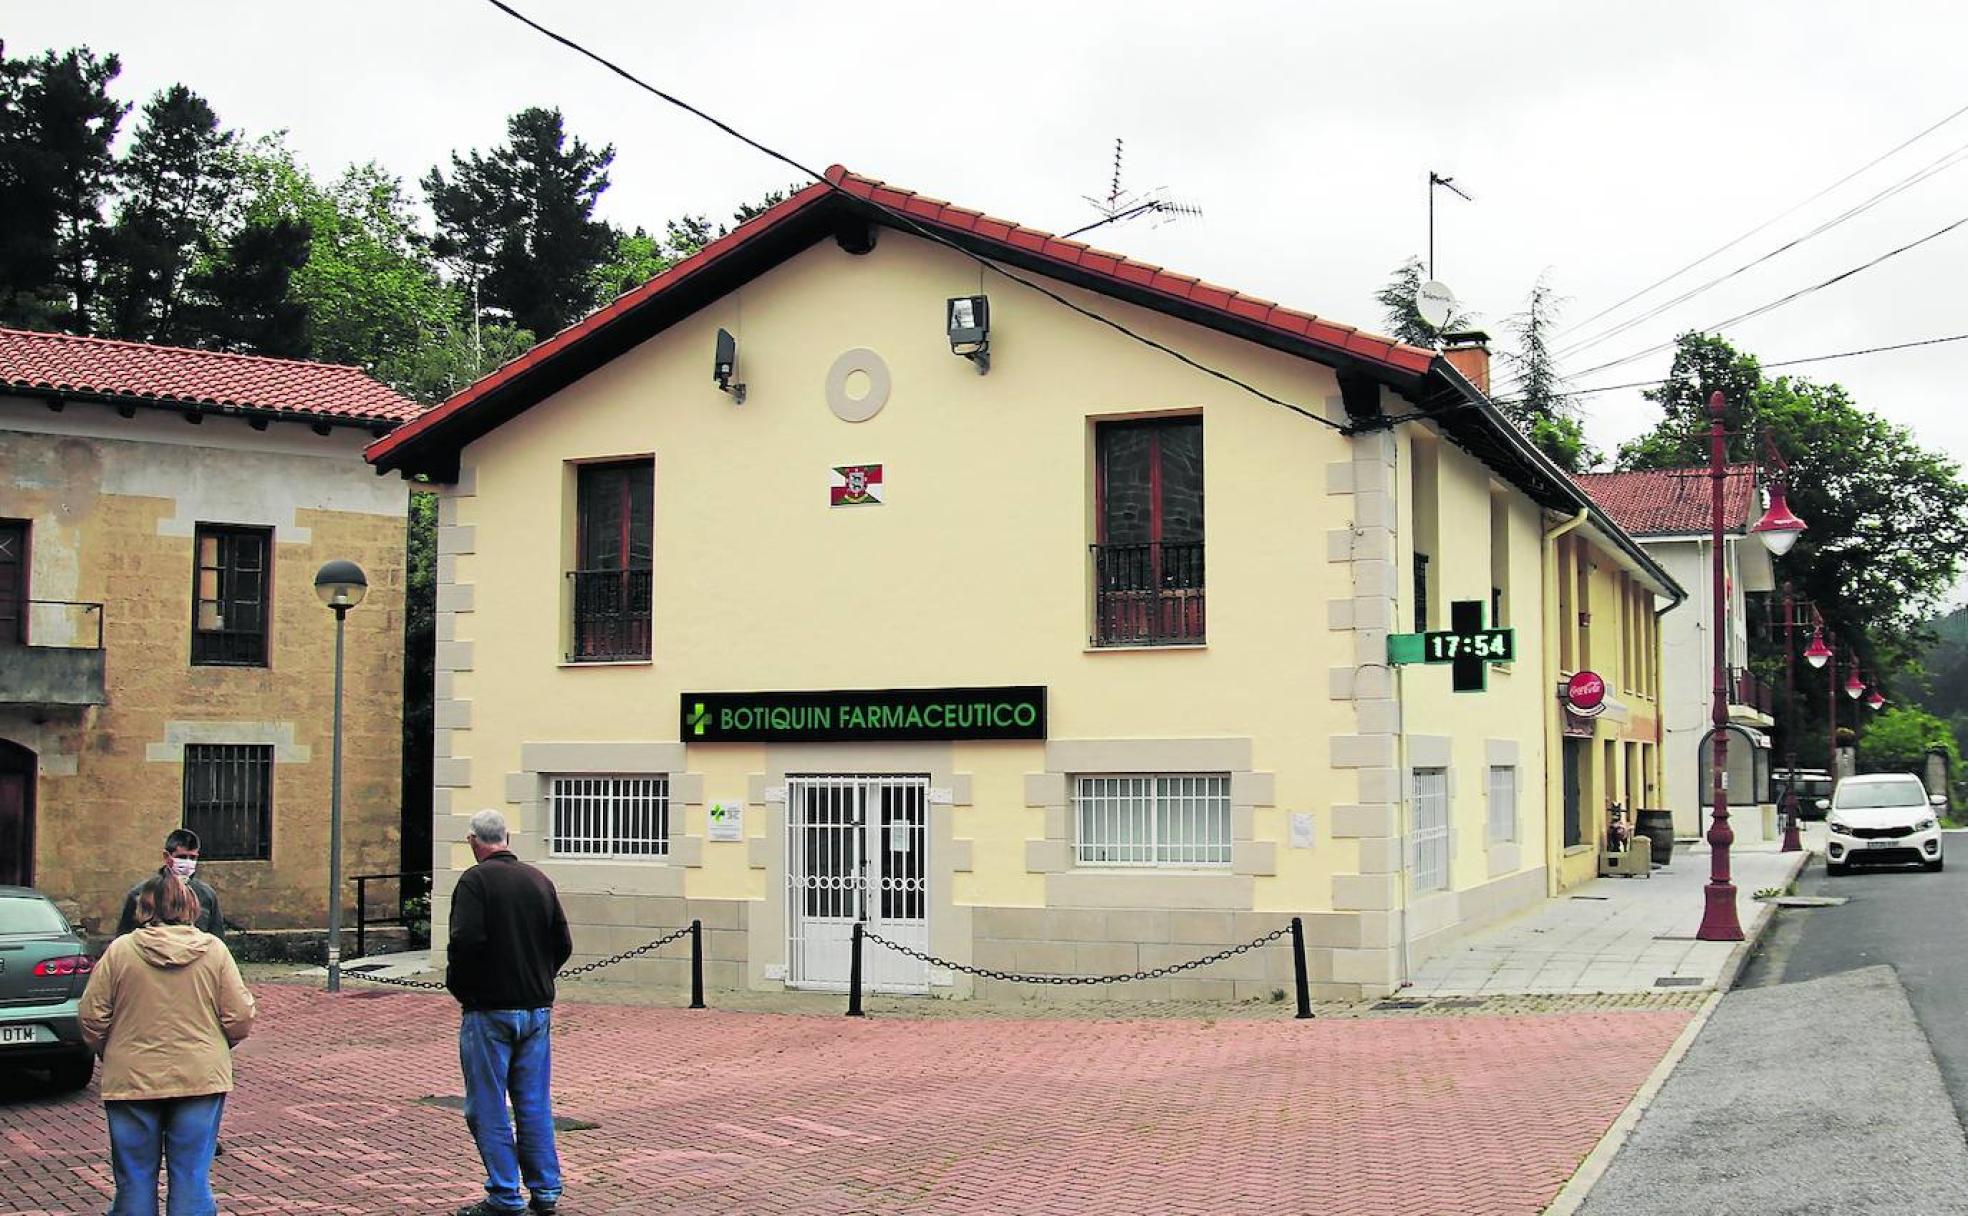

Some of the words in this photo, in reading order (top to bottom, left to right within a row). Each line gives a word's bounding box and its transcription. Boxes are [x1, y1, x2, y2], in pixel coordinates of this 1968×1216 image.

[1431, 634, 1506, 658] 17:54
[720, 706, 830, 731] BOTIQUIN
[839, 702, 1037, 729] FARMACEUTICO
[3, 1027, 33, 1041] DTM
